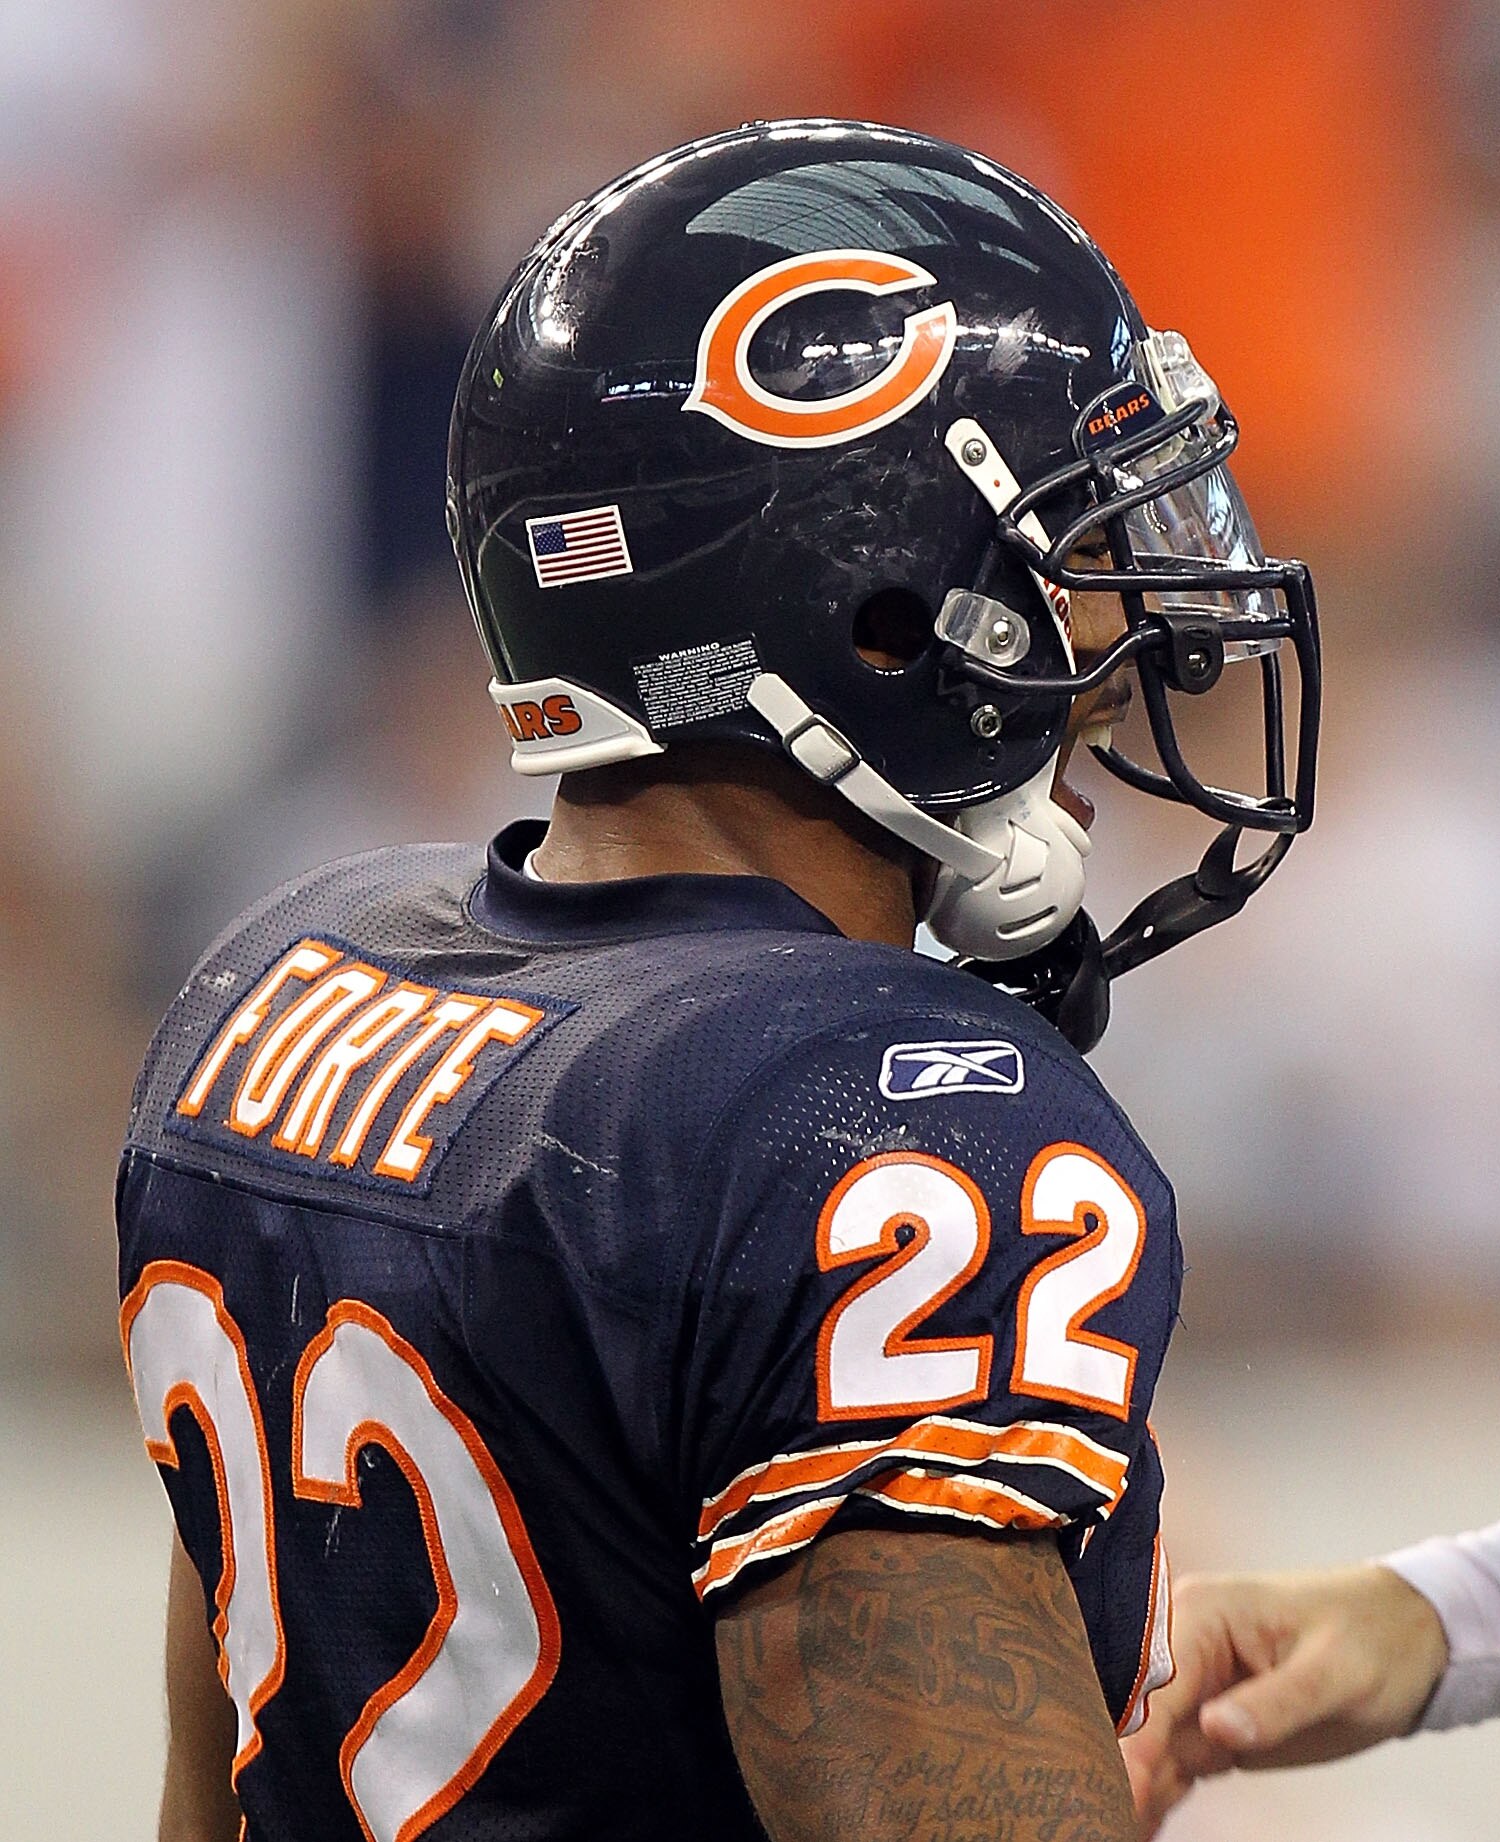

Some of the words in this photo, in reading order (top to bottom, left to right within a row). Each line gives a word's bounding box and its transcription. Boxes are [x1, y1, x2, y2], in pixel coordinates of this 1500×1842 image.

[1088, 392, 1151, 436] BEARS
[176, 938, 545, 1182] FORTE
[816, 1140, 1147, 1423] 22
